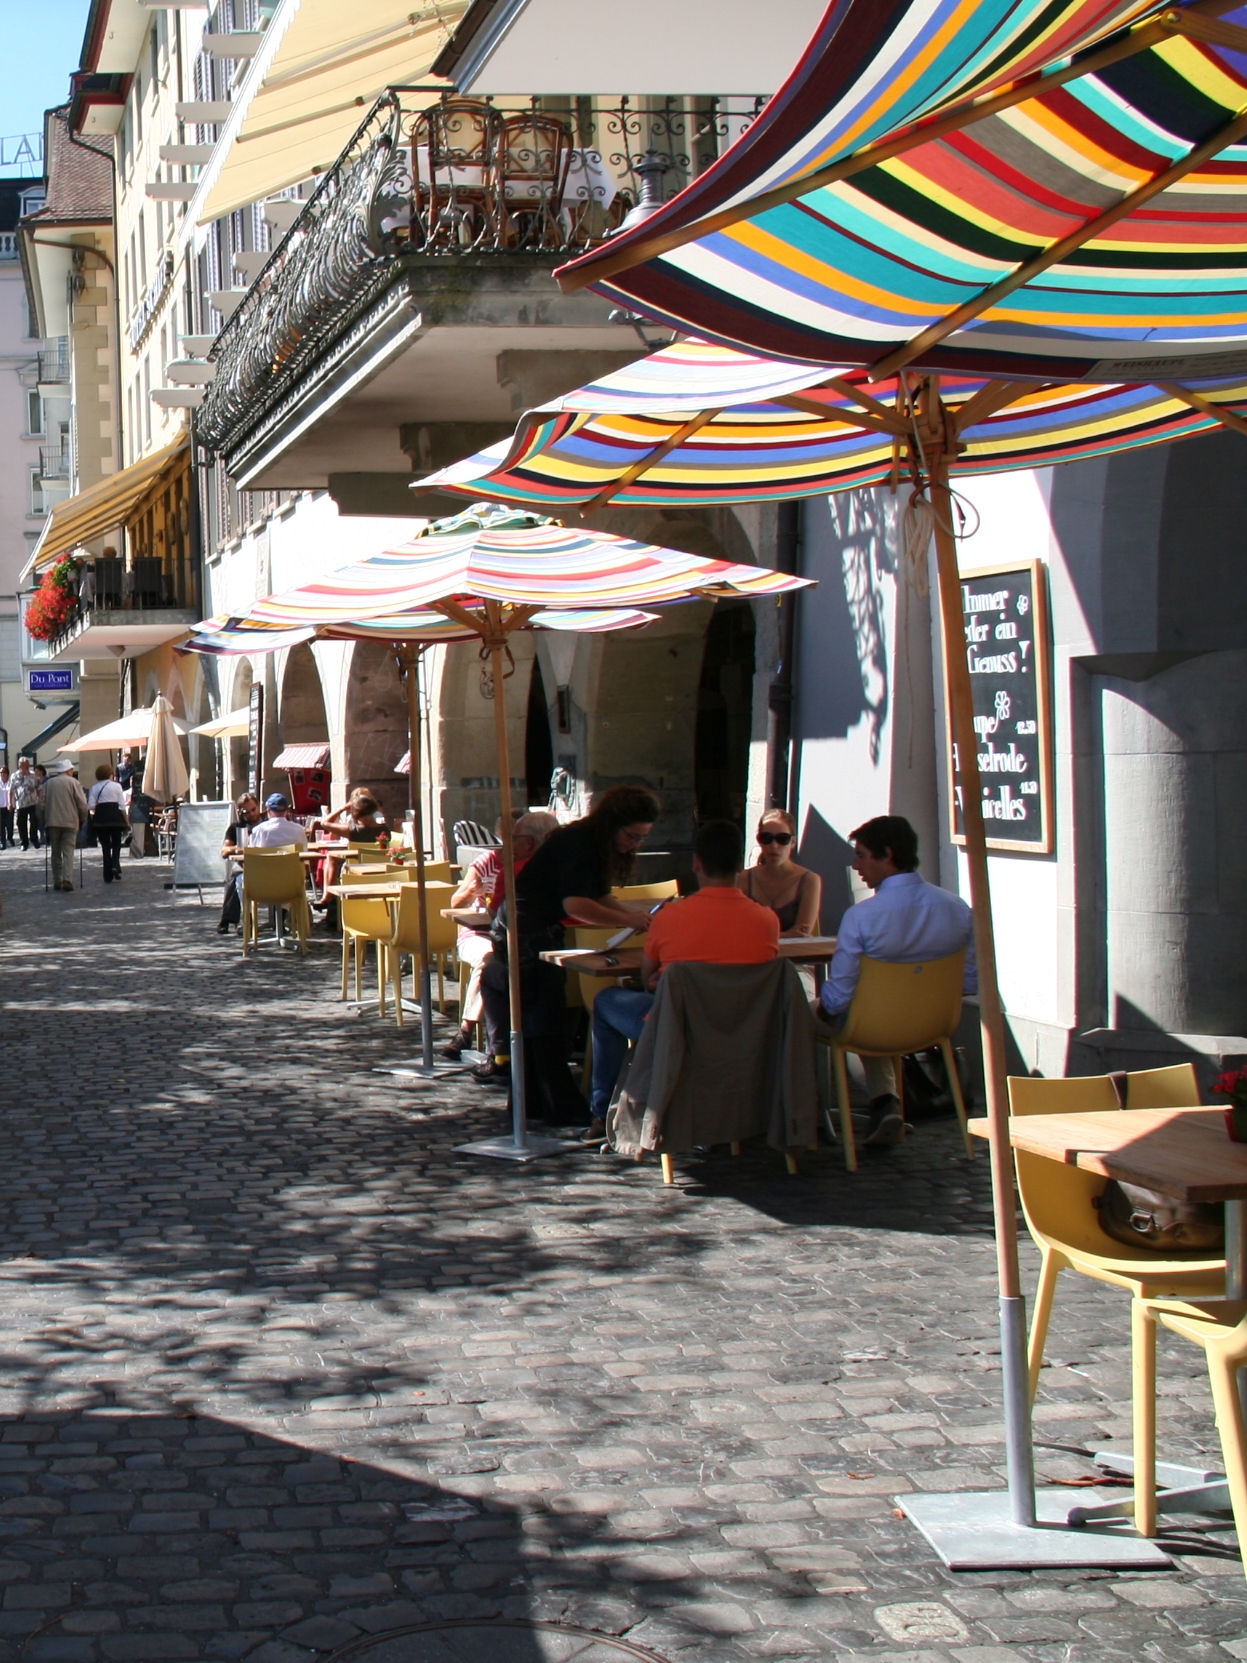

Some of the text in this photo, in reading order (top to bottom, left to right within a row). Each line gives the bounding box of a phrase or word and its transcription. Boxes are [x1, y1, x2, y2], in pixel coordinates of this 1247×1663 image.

[994, 612, 1017, 640] ein
[30, 674, 70, 683] Du Pont
